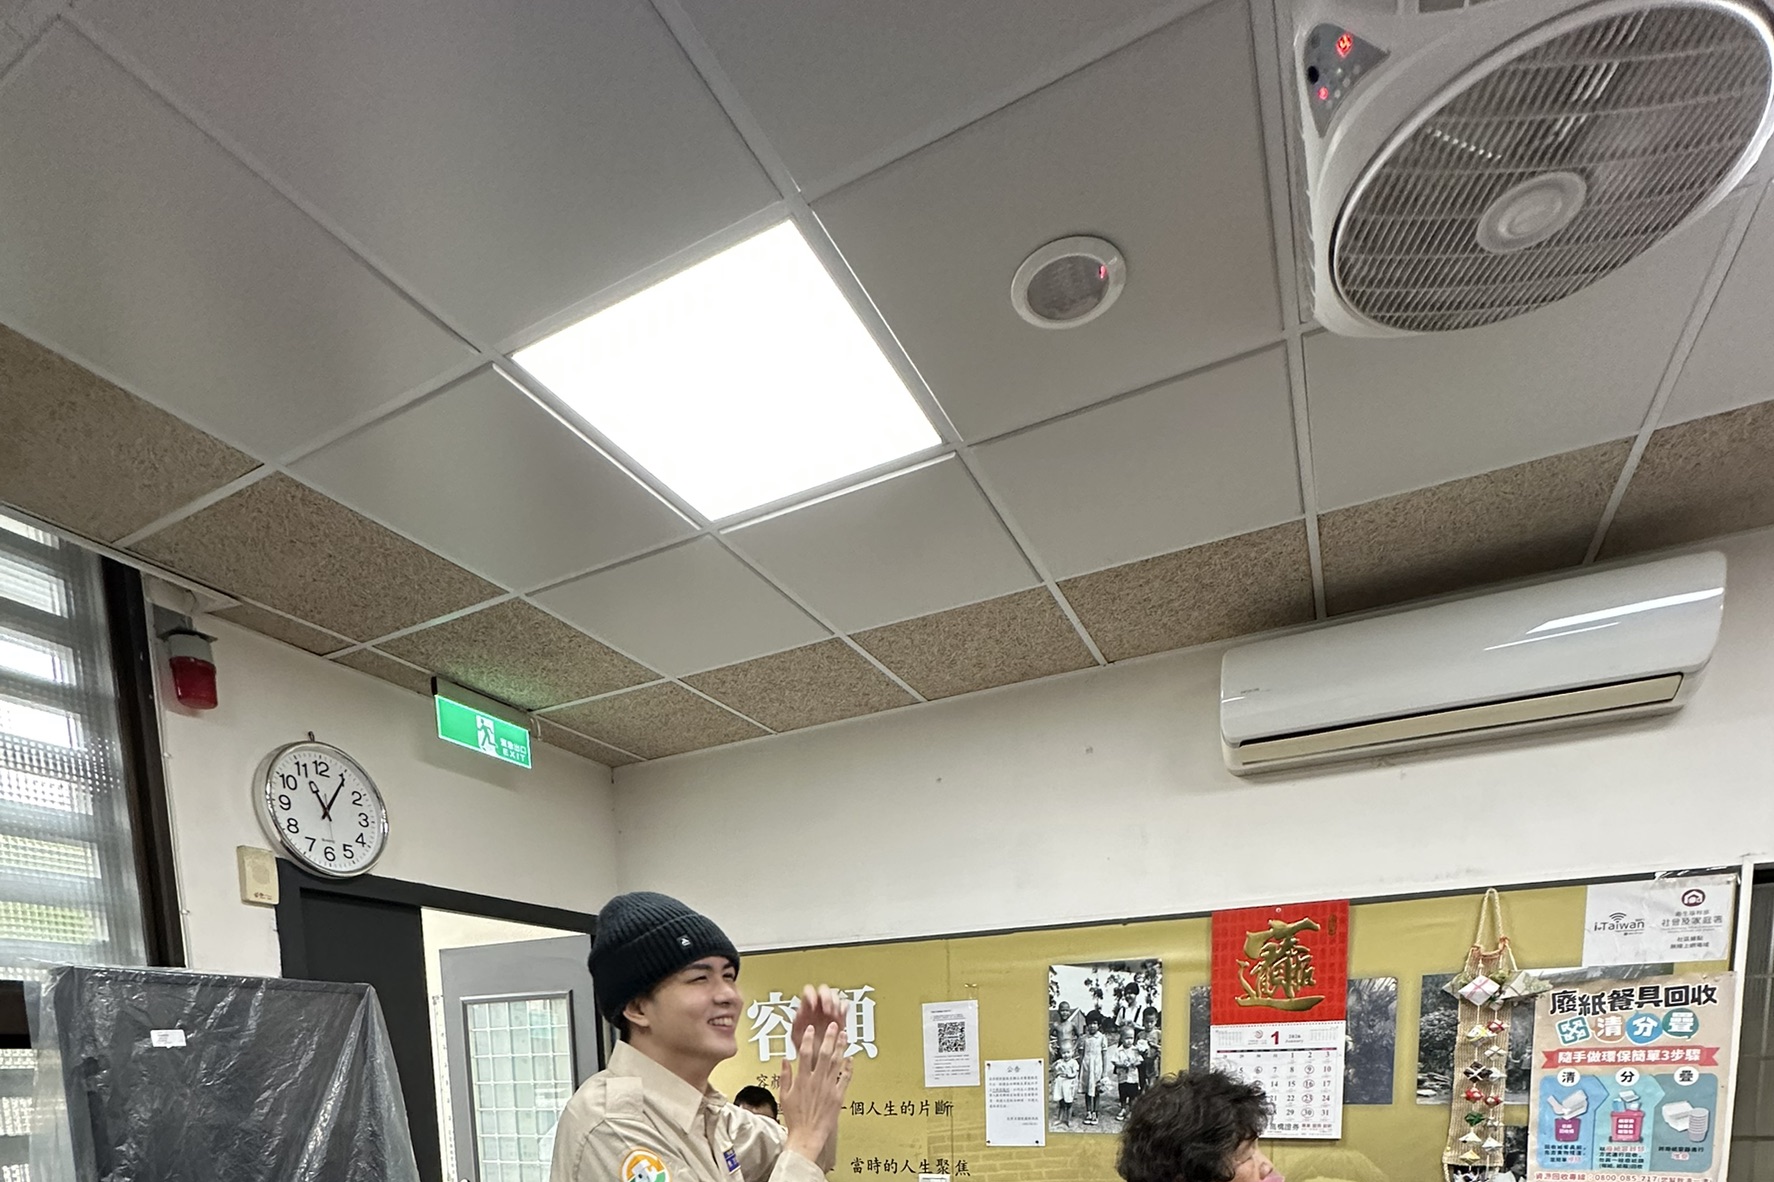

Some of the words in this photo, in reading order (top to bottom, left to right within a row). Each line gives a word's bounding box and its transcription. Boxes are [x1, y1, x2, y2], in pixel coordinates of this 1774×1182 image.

[502, 747, 527, 763] EXIT
[294, 760, 308, 778] 11
[312, 760, 330, 778] 12
[279, 773, 298, 791] 10
[278, 794, 292, 811] 9
[351, 790, 363, 807] 2
[286, 817, 300, 834] 8
[358, 812, 370, 828] 3
[304, 836, 317, 852] 7
[355, 832, 367, 848] 4
[323, 846, 336, 862] 6
[342, 843, 354, 859] 5
[1550, 984, 1718, 1017] 廢紙餐具回收
[1596, 1016, 1623, 1037] 清
[1632, 1016, 1658, 1037] 分
[1271, 1030, 1280, 1045] 1
[1557, 1049, 1702, 1064] 隨手做環保簡單3步驟
[1561, 1071, 1576, 1083] 清
[1620, 1071, 1635, 1083] 分
[1679, 1070, 1694, 1083] 疊
[850, 1156, 971, 1177] 當時的人生聚焦
